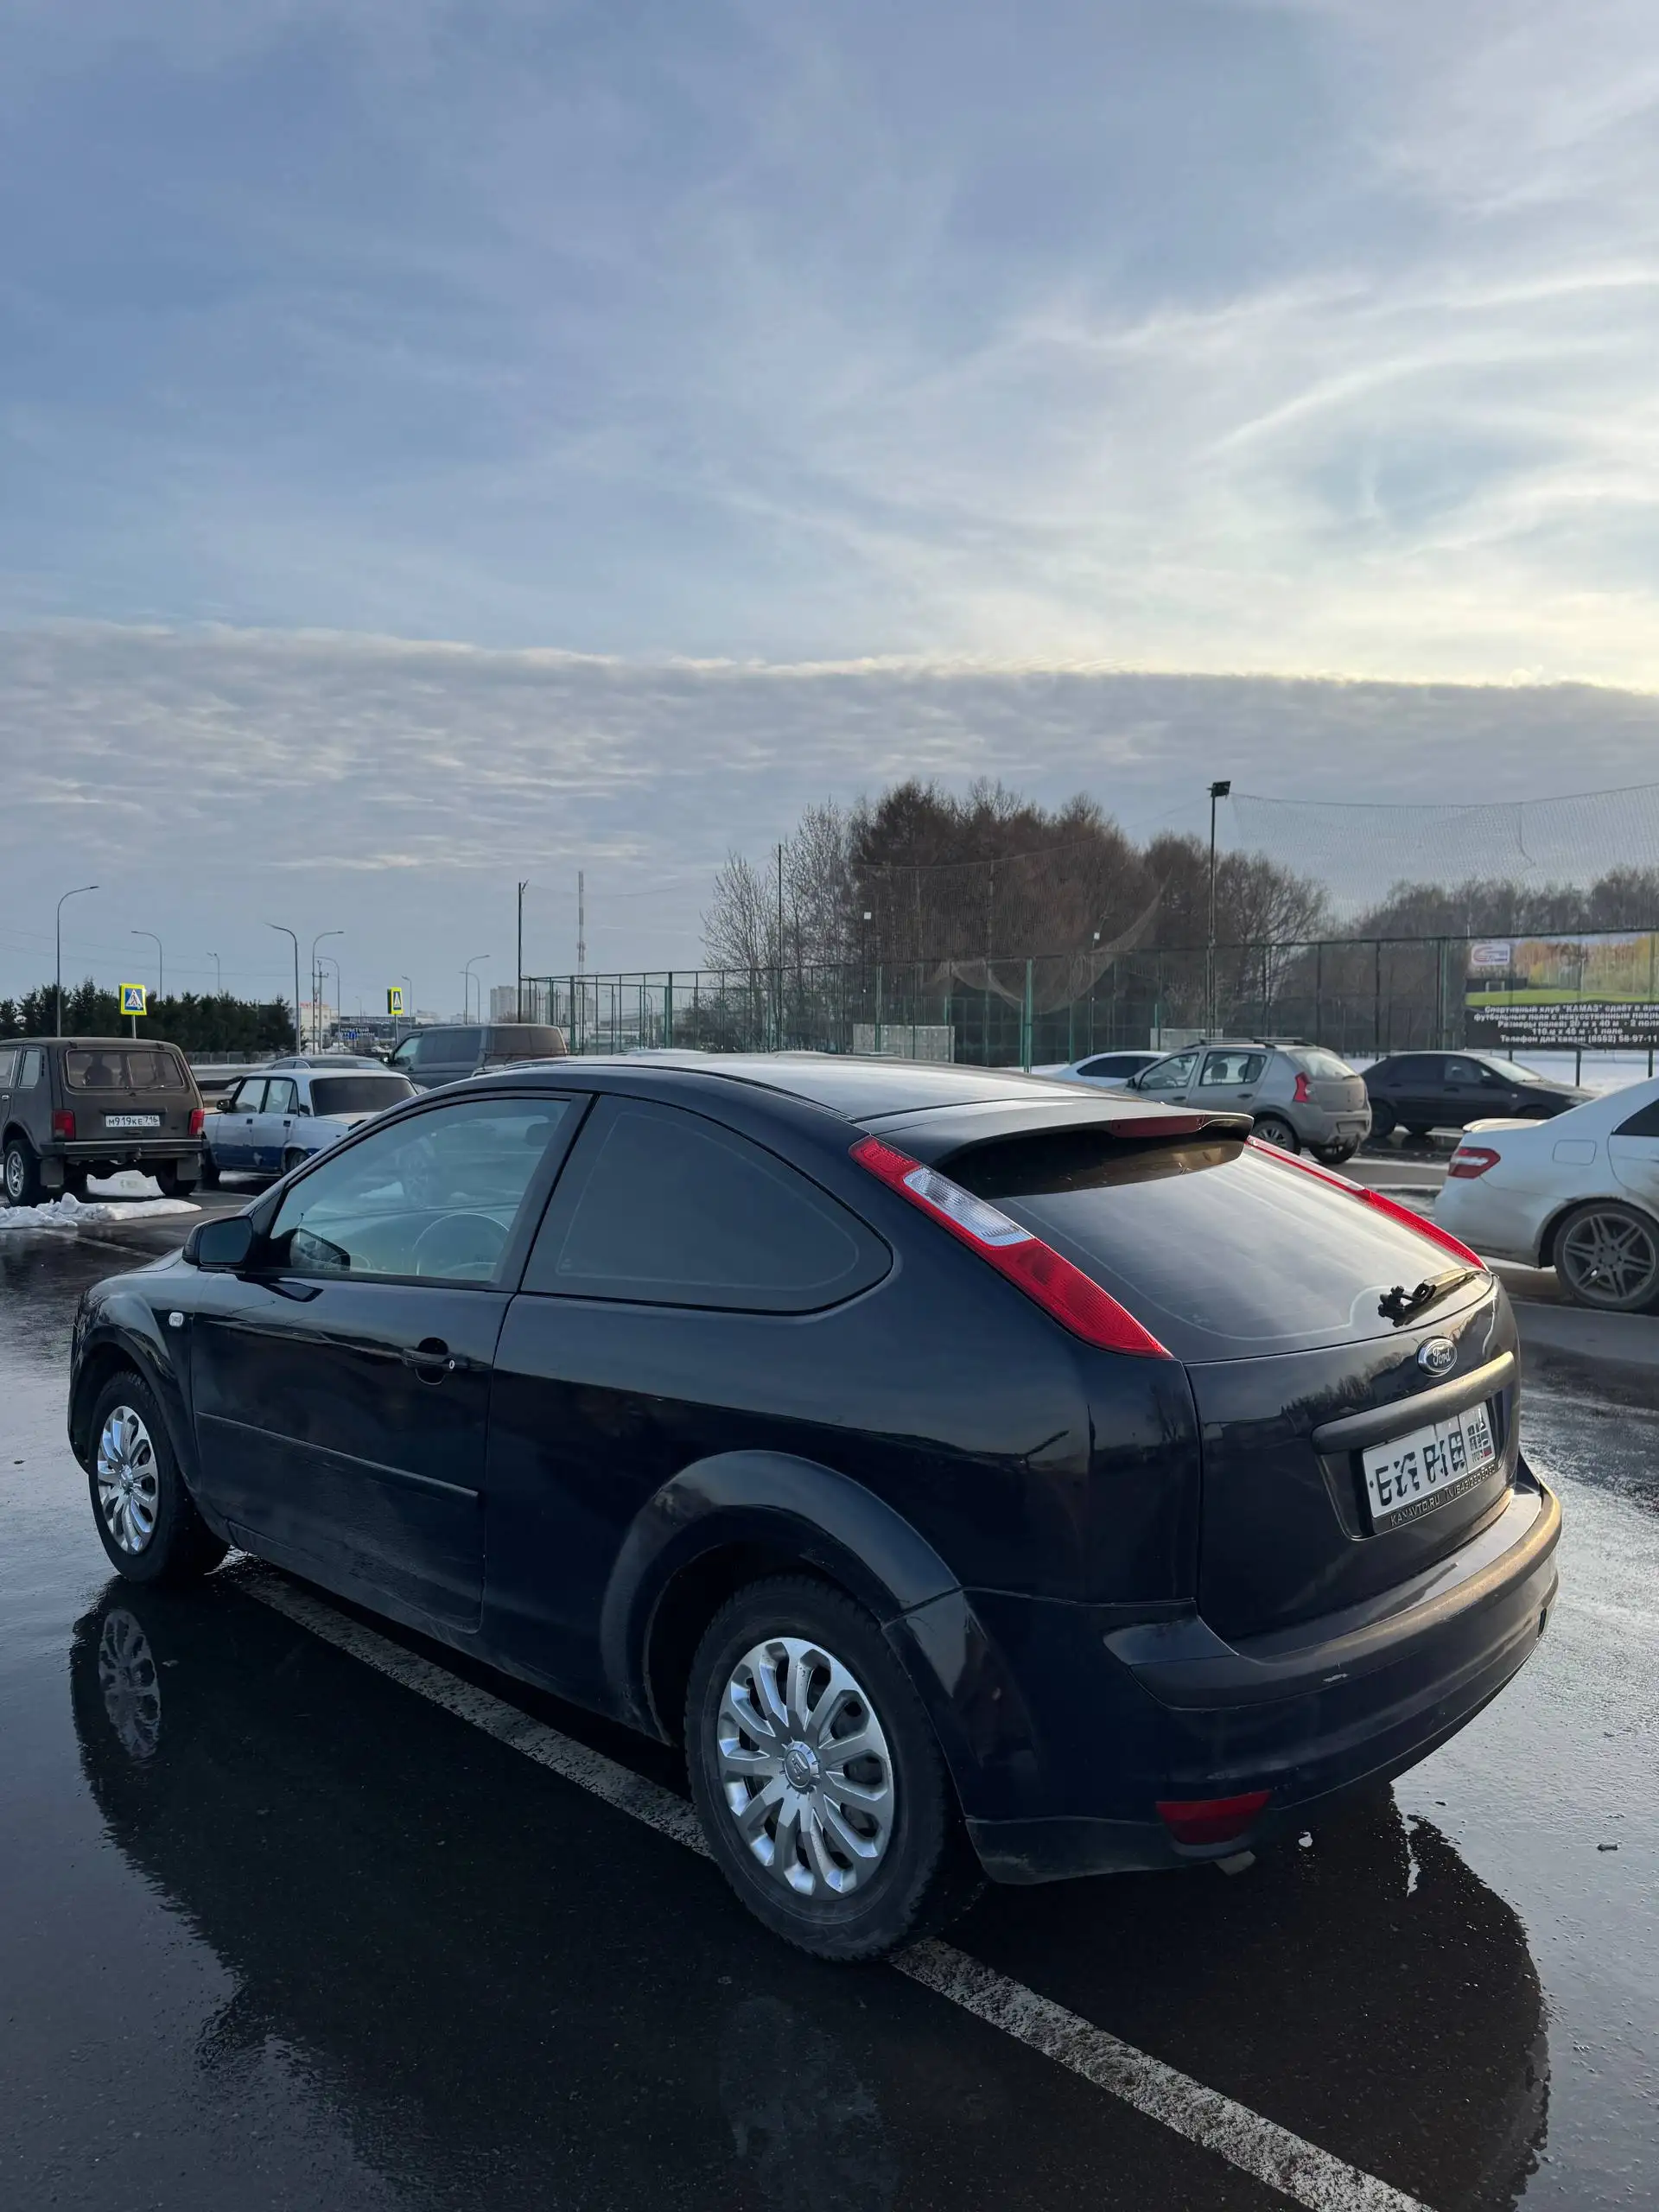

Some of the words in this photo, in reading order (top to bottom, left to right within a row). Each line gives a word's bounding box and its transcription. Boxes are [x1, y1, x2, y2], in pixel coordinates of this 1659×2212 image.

[1485, 1005, 1538, 1014] Спортивный
[1540, 1004, 1560, 1014] клуб
[1562, 1003, 1603, 1013] "КАМАЗ"
[1473, 1013, 1527, 1022] футбольные
[1528, 1013, 1549, 1021] поля
[1551, 1013, 1558, 1021] с
[1497, 1020, 1536, 1029] Размеры
[1599, 1019, 1611, 1028] 40
[1531, 1027, 1548, 1036] 110
[1600, 1027, 1624, 1036] поле
[1500, 1034, 1538, 1044] Телефон
[1540, 1035, 1556, 1044] для
[1432, 1346, 1452, 1366] Ford
